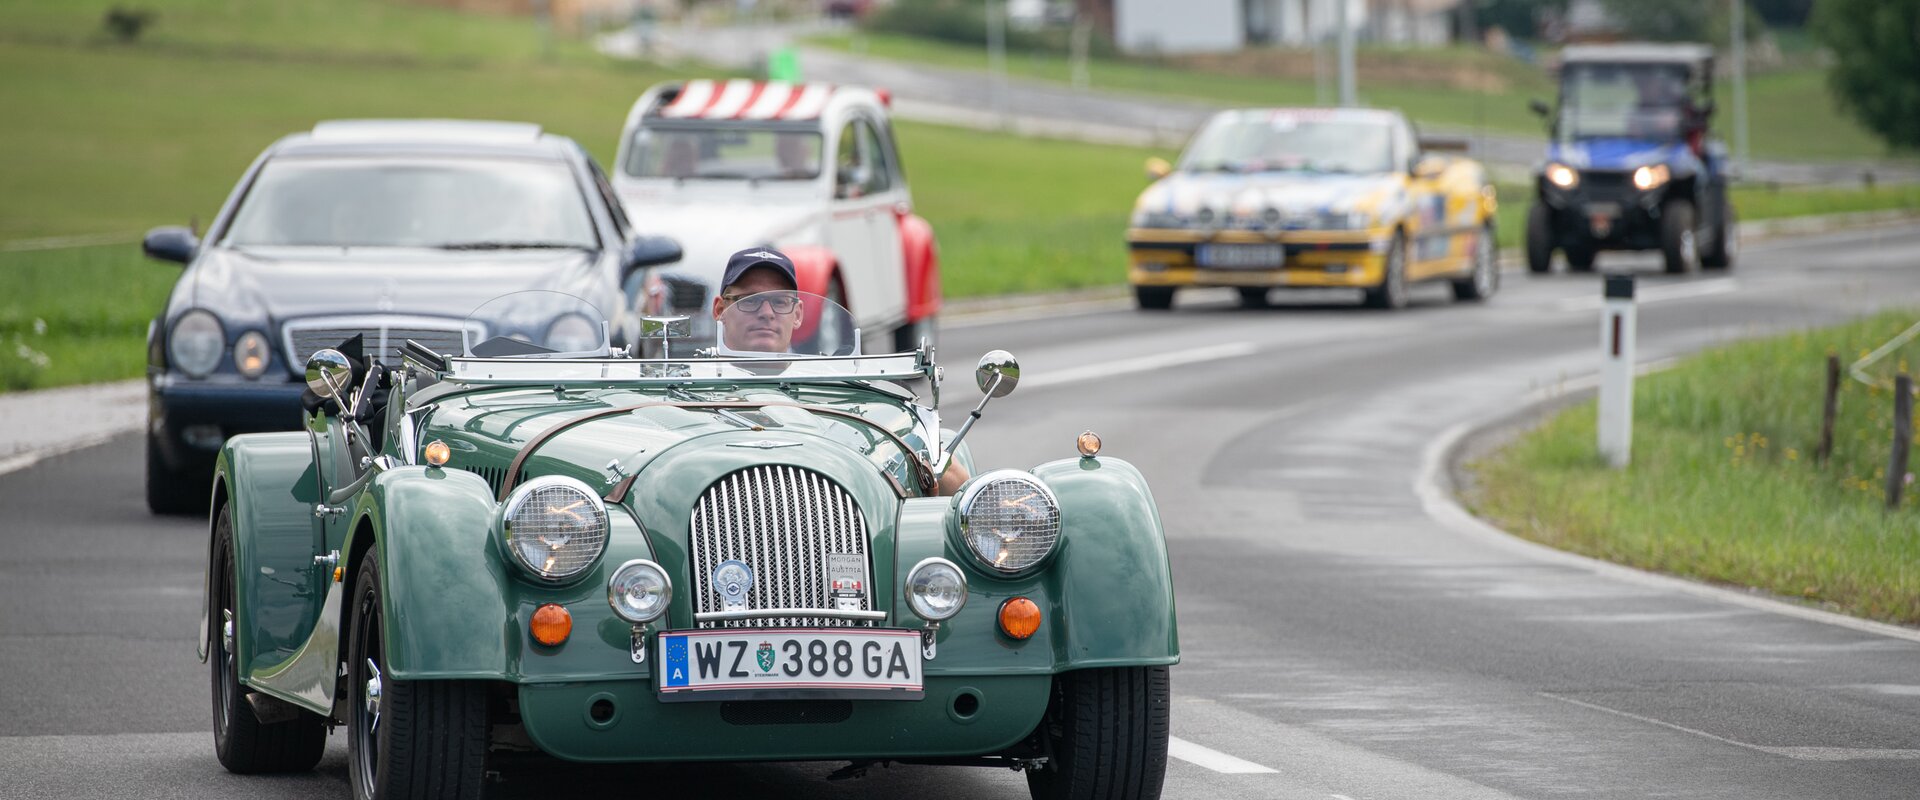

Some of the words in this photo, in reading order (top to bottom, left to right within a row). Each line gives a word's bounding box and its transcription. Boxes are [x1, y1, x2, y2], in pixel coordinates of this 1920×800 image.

[695, 640, 750, 679] WZ
[782, 639, 853, 677] 388
[862, 640, 910, 679] GA
[672, 668, 683, 679] A
